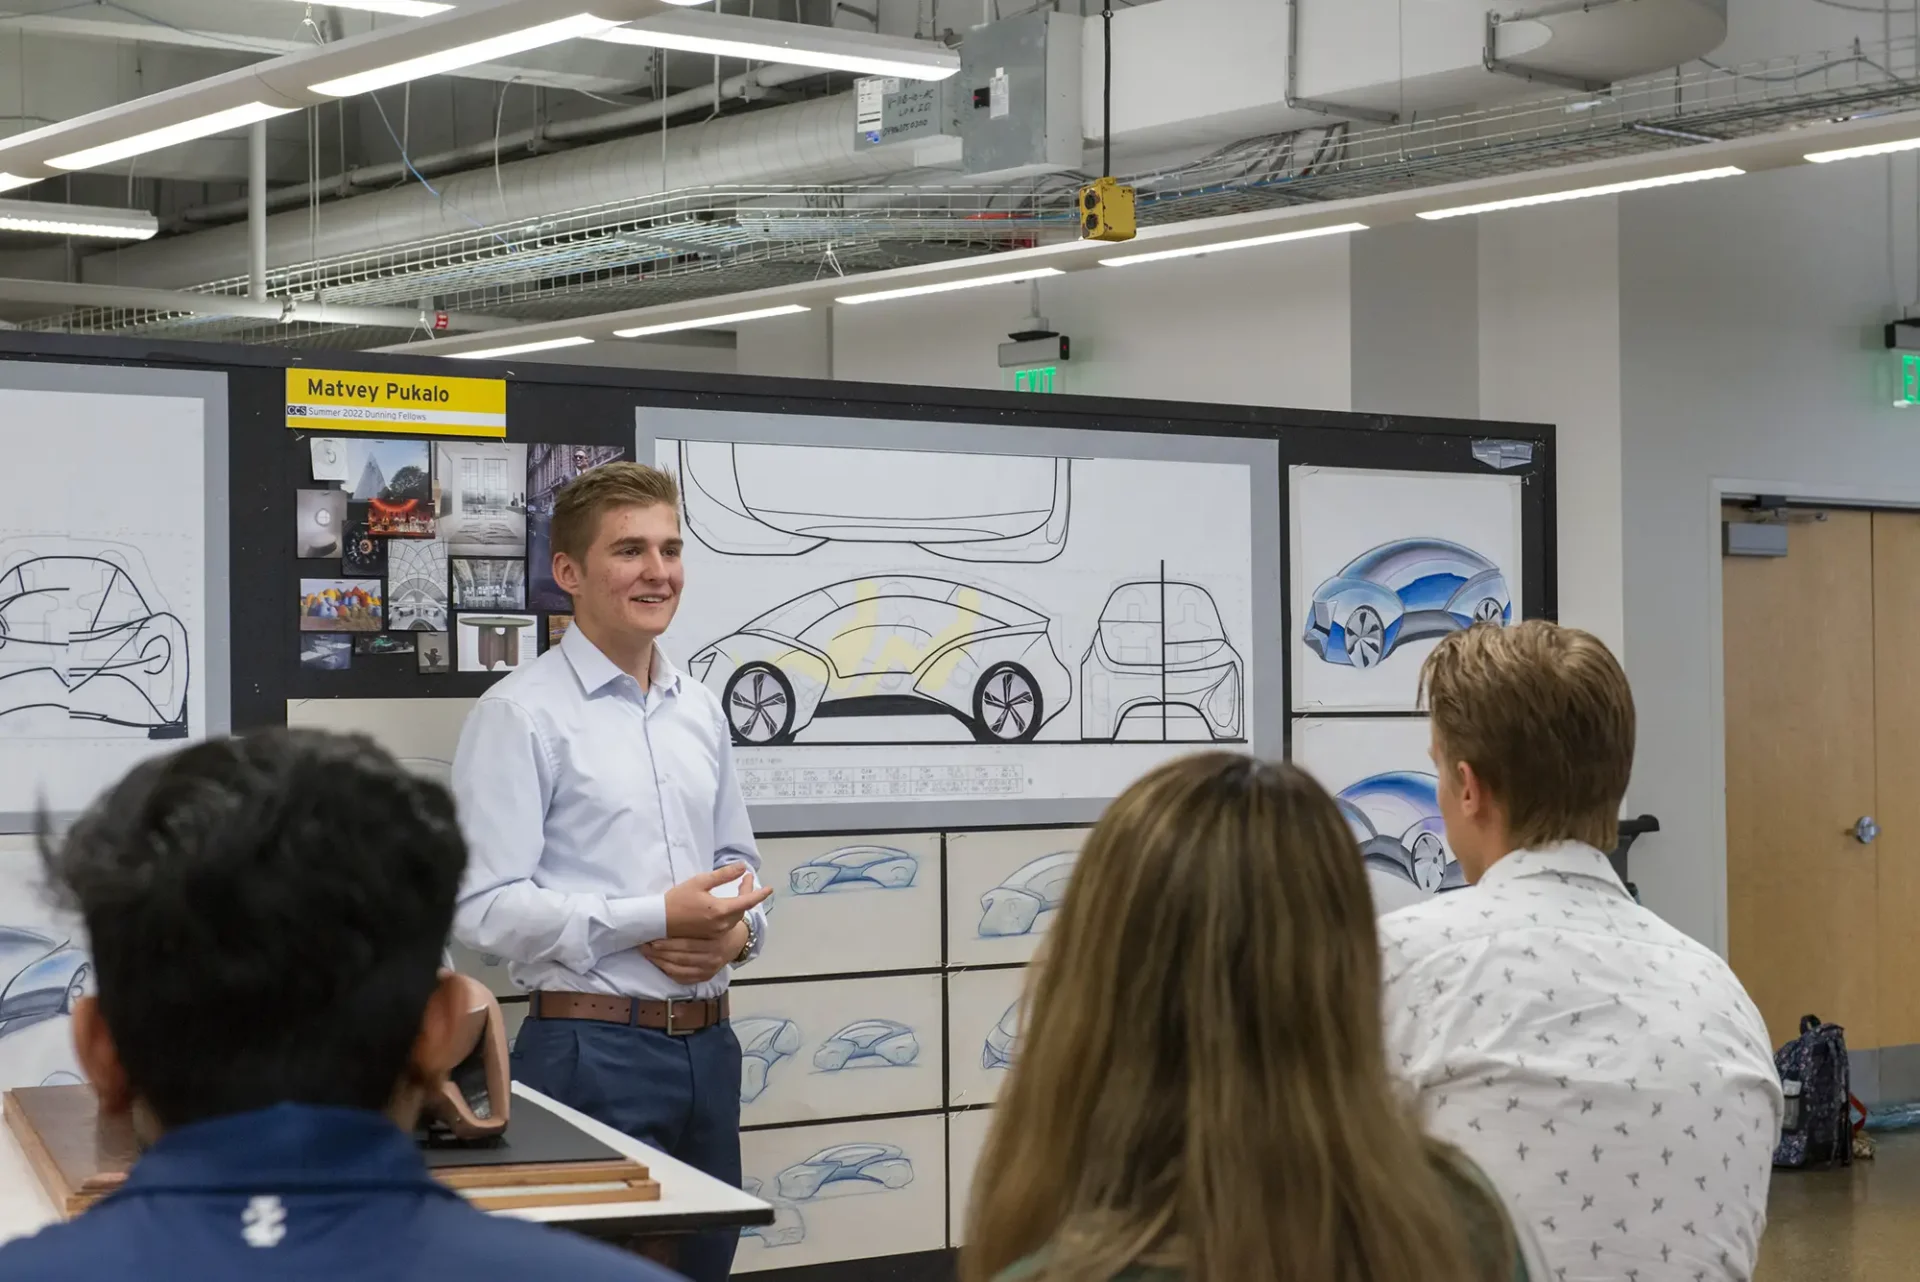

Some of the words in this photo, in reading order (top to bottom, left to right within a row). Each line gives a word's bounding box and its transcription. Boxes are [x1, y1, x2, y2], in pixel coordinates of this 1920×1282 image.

[308, 378, 379, 402] Matvey
[386, 382, 449, 402] Pukalo
[287, 406, 306, 415] CCS
[309, 407, 341, 416] Summer
[343, 408, 363, 417] 2022
[365, 410, 396, 420] Dunning
[398, 411, 426, 420] Fellows
